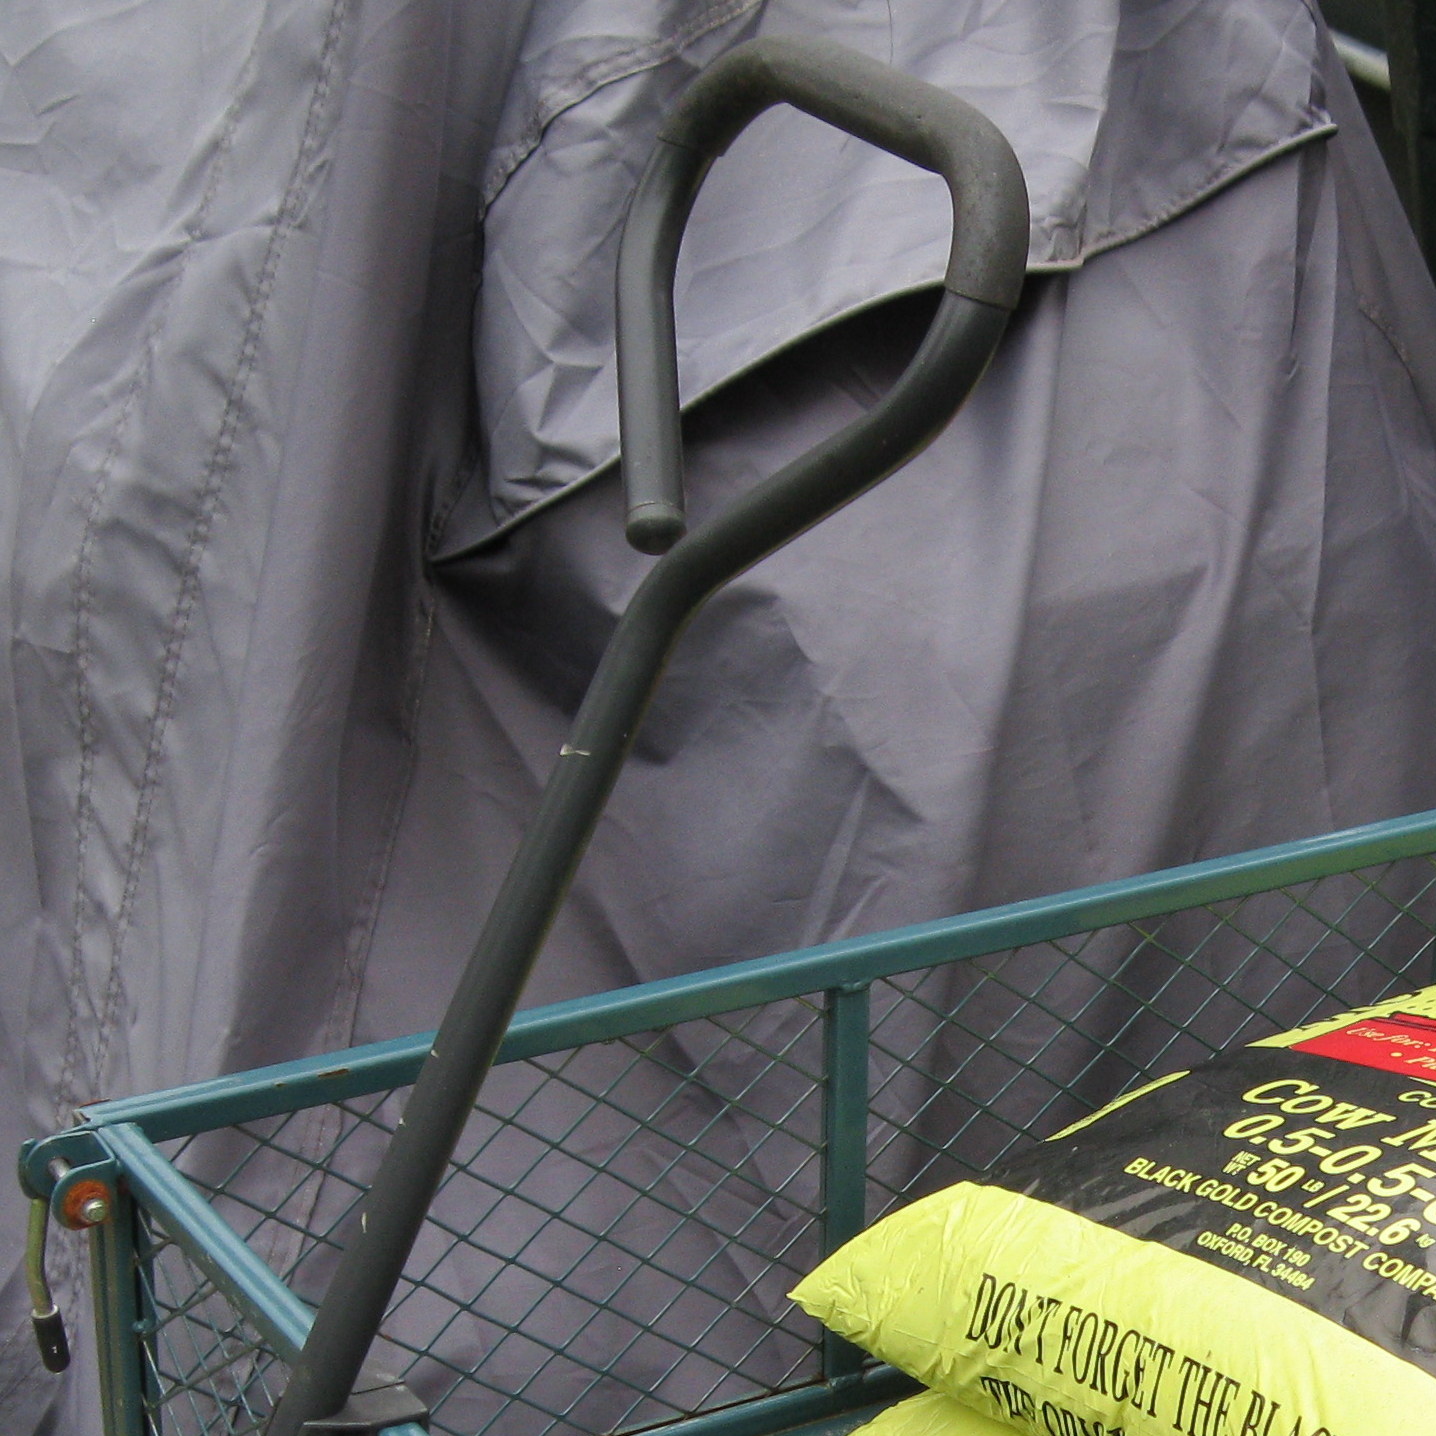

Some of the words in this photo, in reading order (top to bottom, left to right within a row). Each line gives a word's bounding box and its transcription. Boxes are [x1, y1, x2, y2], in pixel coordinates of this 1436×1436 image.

[1346, 1026, 1383, 1041] Use
[1241, 1078, 1397, 1131] Cow
[1231, 1150, 1262, 1167] NET
[1123, 1156, 1203, 1195] BLACK
[1195, 1176, 1257, 1211] GOLD
[1253, 1199, 1371, 1260] COMPOST
[1246, 1157, 1306, 1192] 50
[1301, 1178, 1325, 1193] LB
[1326, 1193, 1421, 1247] 22.6
[1197, 1231, 1255, 1268] OXFORD,
[1251, 1254, 1273, 1273] FL
[1225, 1222, 1251, 1244] P.O.
[1251, 1233, 1287, 1257] BOX
[1283, 1245, 1312, 1268] 190
[965, 1272, 1063, 1365] DON'T
[1053, 1305, 1175, 1418] FORGET
